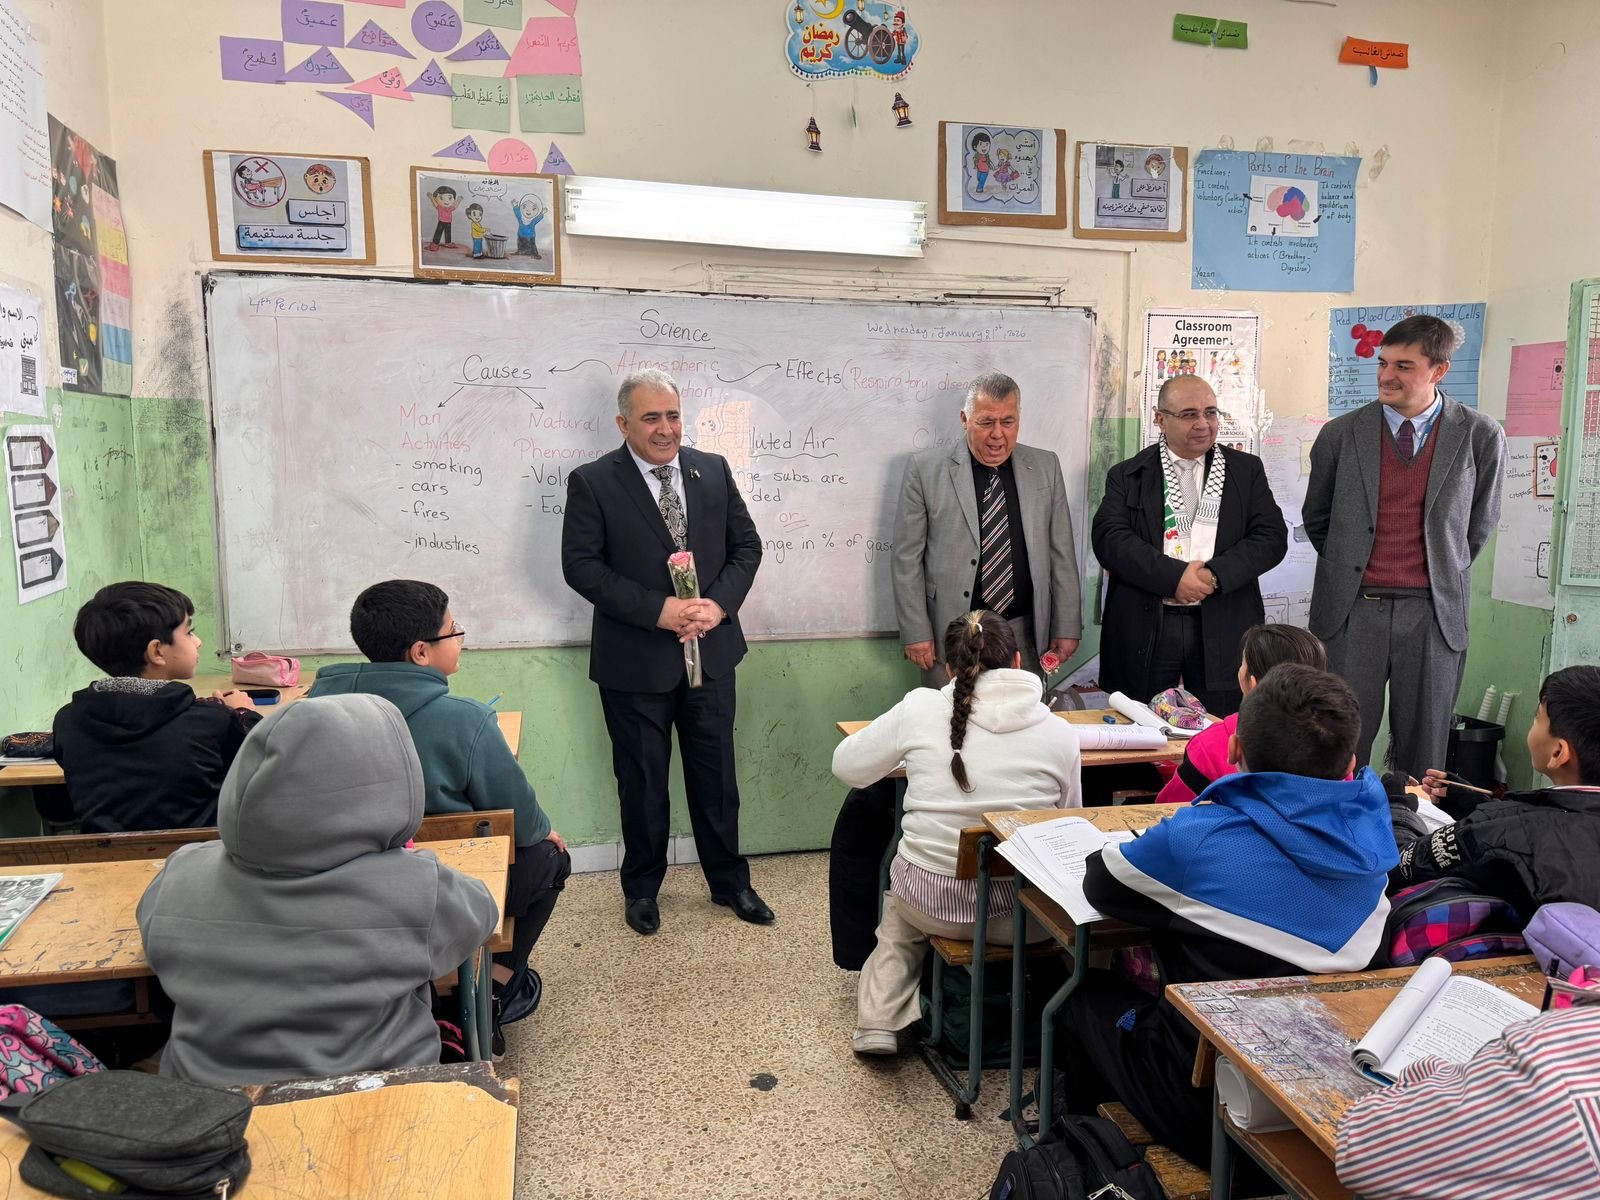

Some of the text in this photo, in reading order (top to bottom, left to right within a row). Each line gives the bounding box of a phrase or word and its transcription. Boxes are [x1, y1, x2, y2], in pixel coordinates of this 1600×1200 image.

[803, 23, 840, 46] رمضان
[800, 43, 833, 64] كريم
[1247, 152, 1272, 173] Parts
[1278, 154, 1291, 174] of
[1294, 157, 1308, 176] the
[274, 298, 317, 313] Period
[1334, 309, 1351, 326] Red
[1357, 306, 1383, 324] Blood
[1384, 306, 1404, 322] Cells
[1458, 303, 1481, 320] Cells
[640, 308, 712, 343] Science
[1175, 320, 1233, 332] Classroom
[462, 354, 532, 382] Causes
[786, 358, 842, 385] Effects
[400, 402, 441, 428] Man
[528, 411, 600, 434] Natural
[400, 431, 471, 452] Activities
[802, 426, 835, 451] Air
[411, 457, 483, 487] smoking
[820, 473, 849, 485] are
[411, 481, 449, 496] cars
[413, 500, 450, 521] fires
[801, 536, 816, 550] in
[821, 531, 835, 548] %
[846, 533, 863, 547] of
